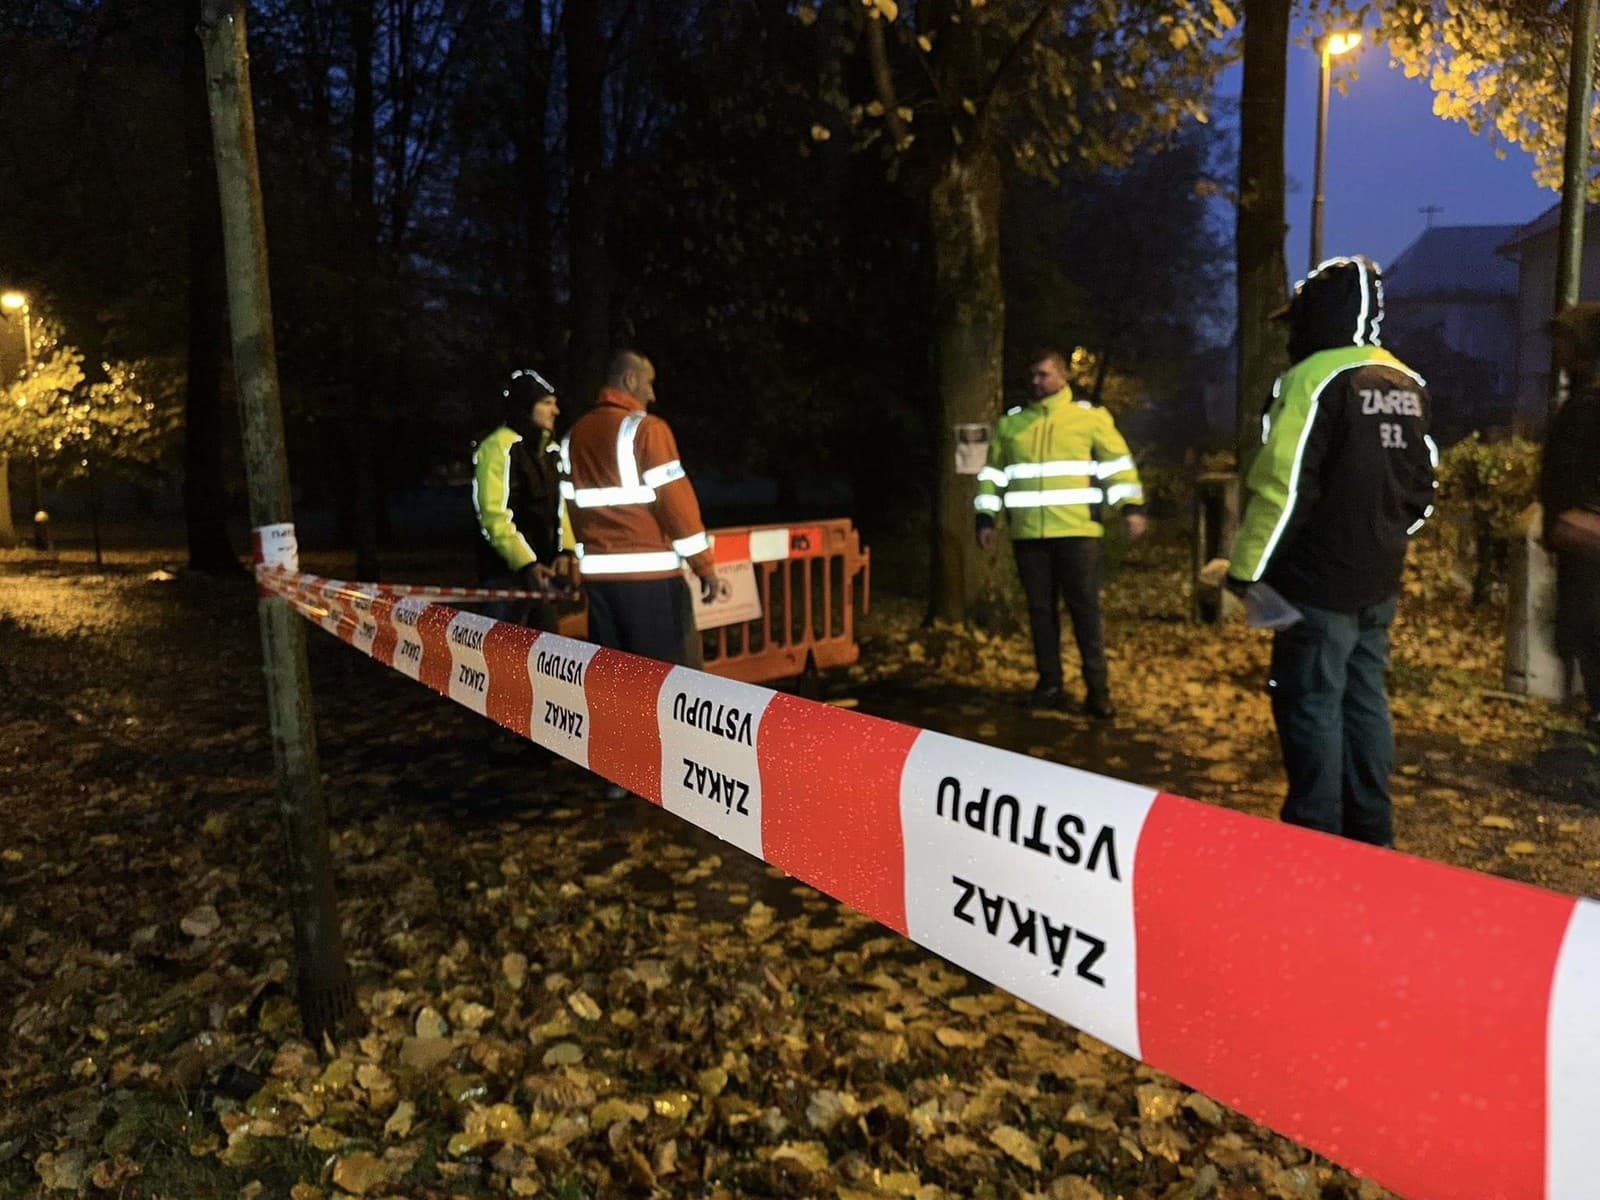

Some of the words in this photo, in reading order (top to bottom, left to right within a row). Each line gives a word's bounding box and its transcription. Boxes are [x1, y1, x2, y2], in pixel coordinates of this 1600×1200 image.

[451, 625, 484, 651] VSTUPU
[536, 651, 582, 687] VSTUPU
[544, 700, 583, 739] ZÁKAZ
[673, 692, 752, 746] VSTUPU
[683, 758, 750, 816] ZÁKAZ
[936, 776, 1122, 882] VSTUPU
[952, 875, 1106, 988] ZÁKAZ
